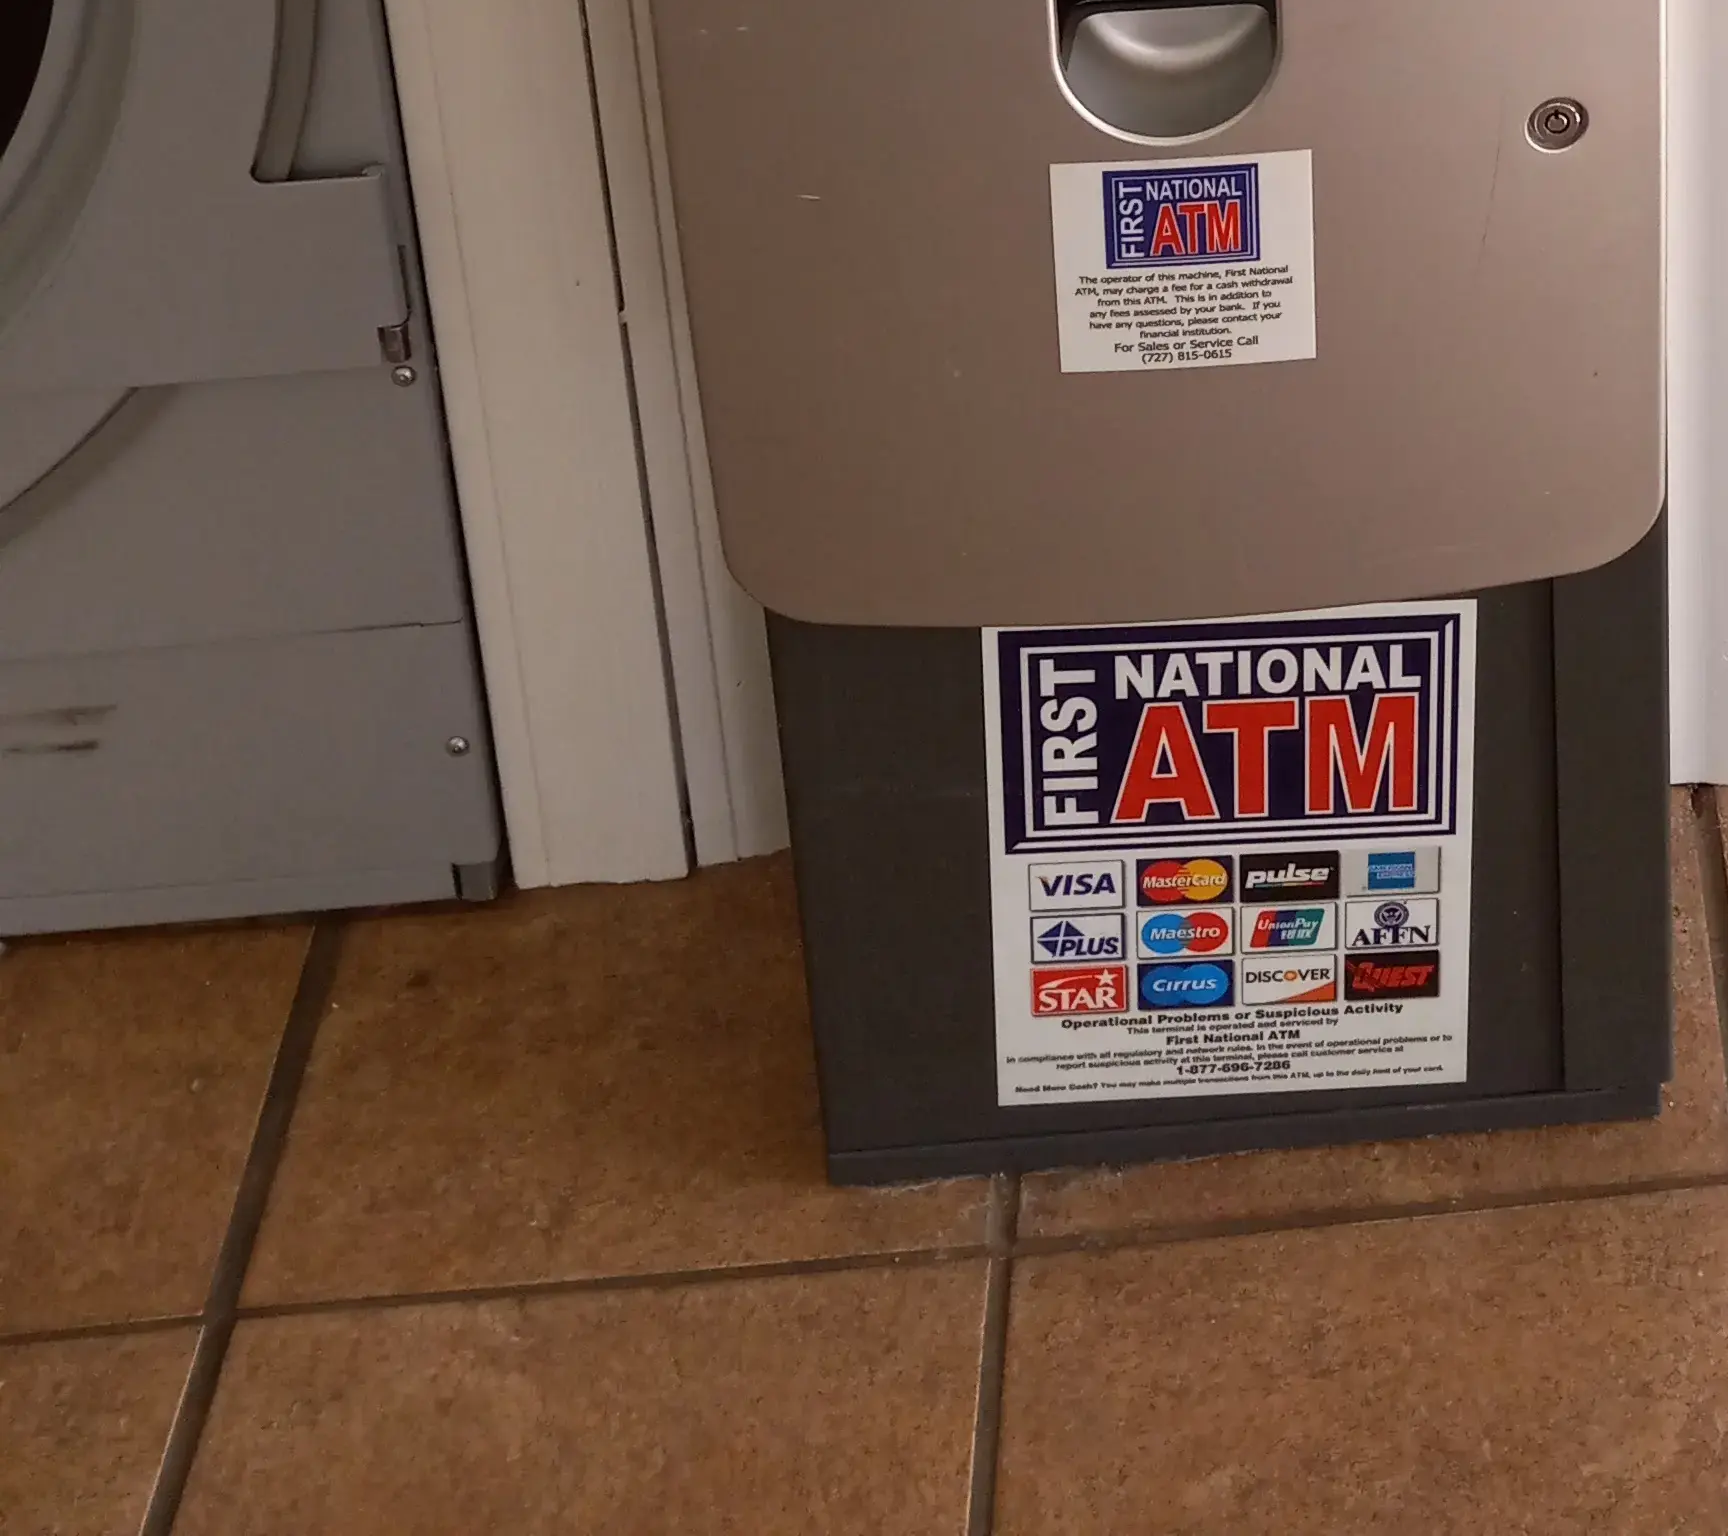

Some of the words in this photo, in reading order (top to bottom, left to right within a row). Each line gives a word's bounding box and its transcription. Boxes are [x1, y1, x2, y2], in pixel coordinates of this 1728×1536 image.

[1146, 177, 1243, 201] NATIONAL
[1119, 182, 1145, 258] FIRST
[1150, 199, 1242, 257] ATM
[1079, 276, 1098, 284] The
[1101, 274, 1142, 285] operator
[1145, 274, 1156, 283] of
[1158, 273, 1176, 281] this
[1225, 268, 1246, 277] First
[1250, 265, 1289, 276] National
[1103, 287, 1123, 296] may
[1126, 285, 1159, 295] charge
[1172, 283, 1187, 292] fee
[1190, 283, 1204, 291] for
[1216, 280, 1239, 289] cash
[1241, 277, 1293, 288] withdrawal
[1098, 298, 1120, 307] from
[1123, 297, 1141, 305] this
[1175, 295, 1195, 303] This
[1198, 294, 1206, 302] is
[1209, 293, 1217, 301] in
[1221, 291, 1259, 301] addition
[1262, 290, 1272, 298] to
[1090, 310, 1107, 320] any
[1110, 309, 1130, 317] fees
[1134, 307, 1177, 317] assessed
[1180, 306, 1192, 316] by
[1195, 305, 1216, 314] your
[1253, 302, 1260, 310] If
[1263, 301, 1281, 310] you
[1089, 321, 1113, 330] have
[1115, 321, 1132, 331] any
[1188, 317, 1219, 327] please
[1222, 314, 1258, 324] contact
[1261, 312, 1283, 321] your
[1140, 330, 1180, 339] financial
[1114, 343, 1134, 354] For
[1138, 341, 1169, 352] Sales
[1173, 342, 1185, 350] or
[1190, 338, 1233, 349] Service
[1237, 336, 1259, 346] Call
[1142, 352, 1174, 365] (727)
[1178, 349, 1232, 361] 815-0615
[1115, 644, 1422, 700] NATIONAL
[1040, 659, 1099, 827] FIRST
[1110, 692, 1420, 824] ATM
[1143, 873, 1227, 889] MasterCard
[1245, 861, 1330, 889] pulse
[1037, 873, 1116, 897] VISA
[1150, 927, 1221, 940] Maestro
[1258, 918, 1319, 930] UnionPay
[1352, 925, 1431, 946] AFFN
[1060, 937, 1120, 957] PLUS
[1153, 978, 1218, 992] Cirrus
[1246, 968, 1331, 984] DISCOVER
[1039, 988, 1118, 1012] STAR
[1062, 1015, 1152, 1030] Operational
[1158, 1012, 1230, 1024] Problems
[1235, 1011, 1251, 1020] or
[1256, 1006, 1339, 1020] Suspicious
[1344, 1003, 1403, 1015] Activity
[1166, 1035, 1199, 1046] First
[1204, 1031, 1263, 1045] National
[1268, 1030, 1300, 1040] ATM
